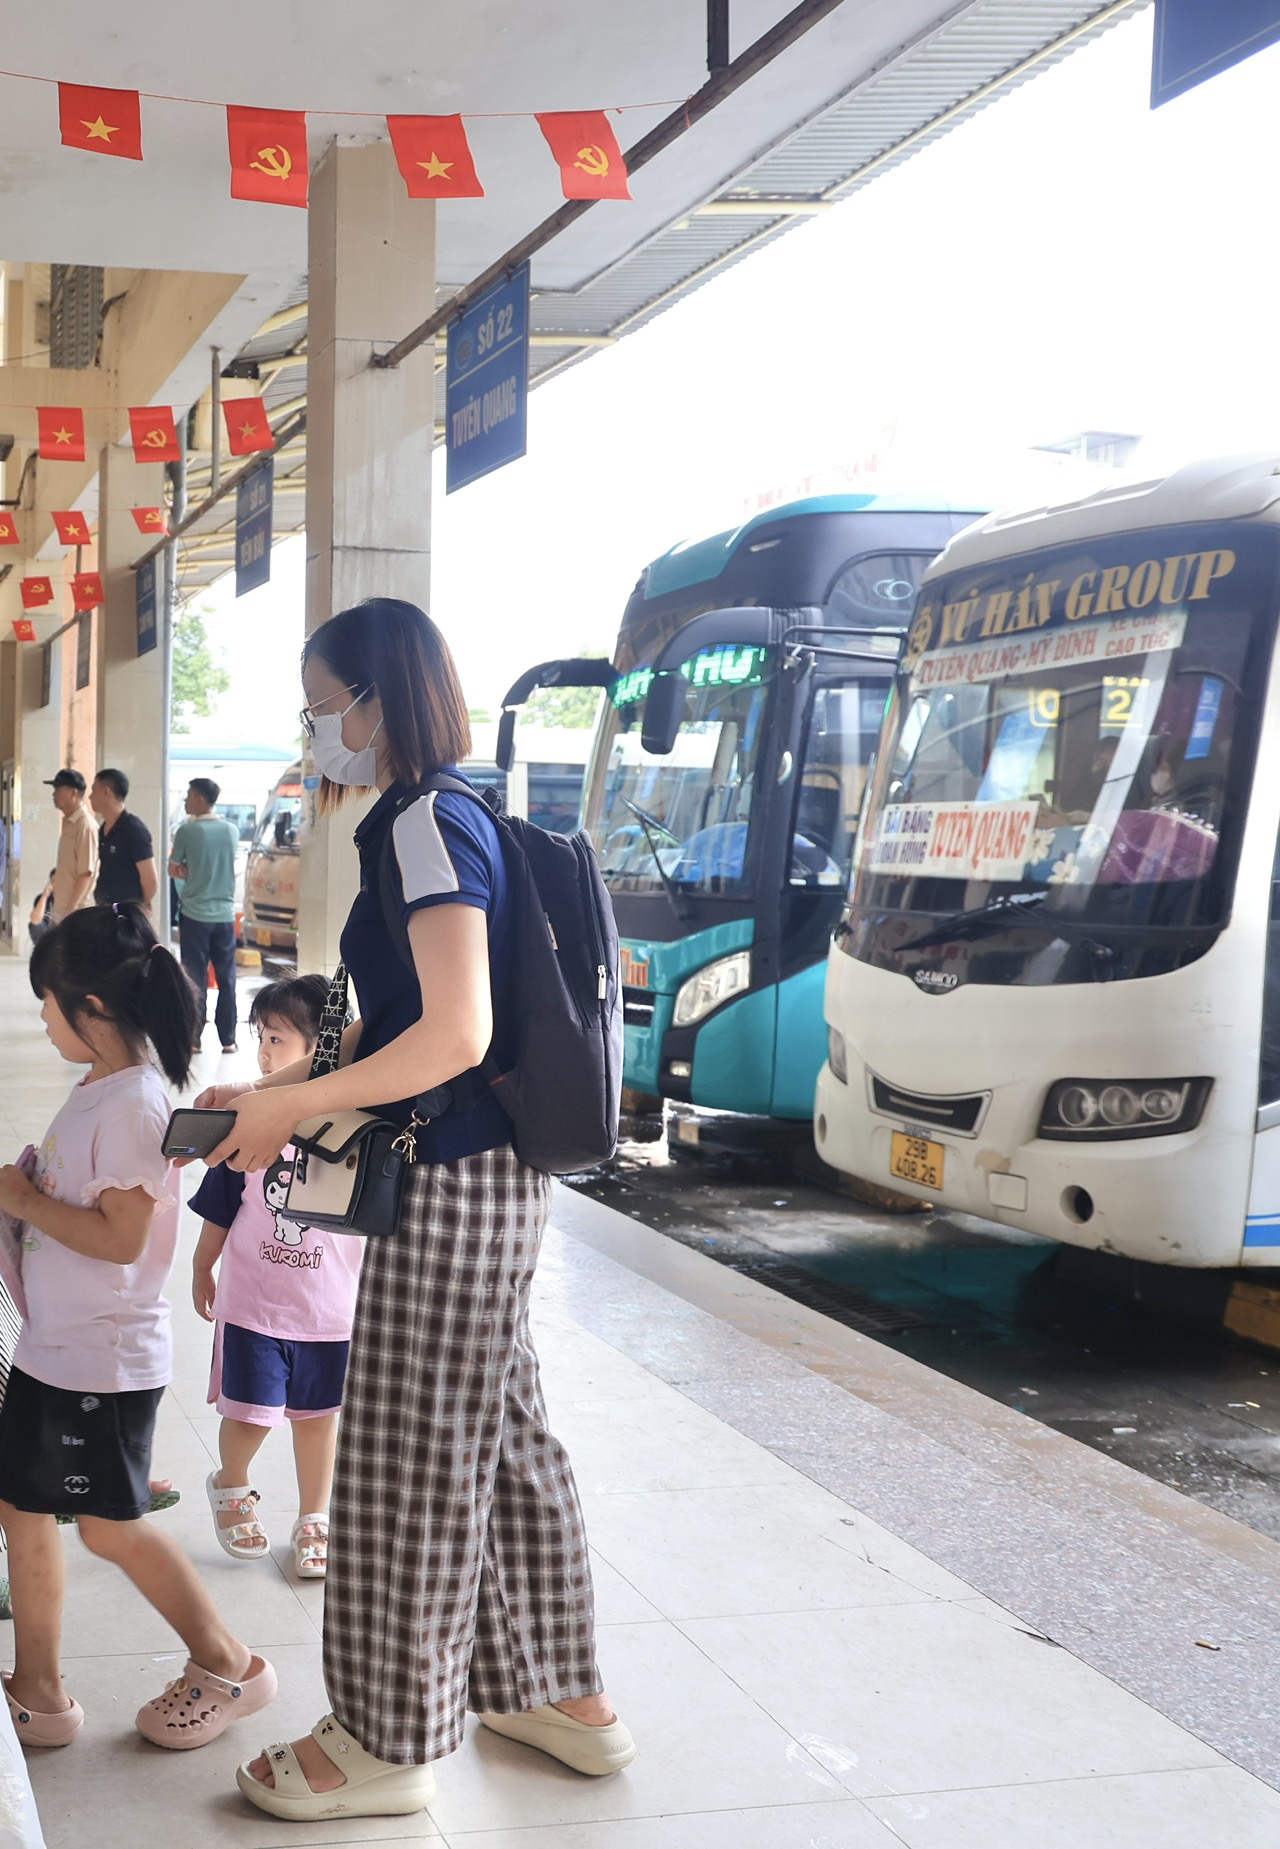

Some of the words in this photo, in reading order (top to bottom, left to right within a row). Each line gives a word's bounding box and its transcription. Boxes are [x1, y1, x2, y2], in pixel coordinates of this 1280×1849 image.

[477, 305, 495, 355] SỐ
[497, 303, 514, 342] 22
[452, 395, 481, 449] TUYÊN
[483, 375, 517, 434] QUANG
[979, 572, 1062, 637] HÁN
[1065, 549, 1236, 620] GROUP
[967, 643, 1022, 682] QUANG
[1105, 635, 1136, 657] CAO
[929, 804, 978, 857] TUYÊN
[974, 811, 1031, 869] QUANG
